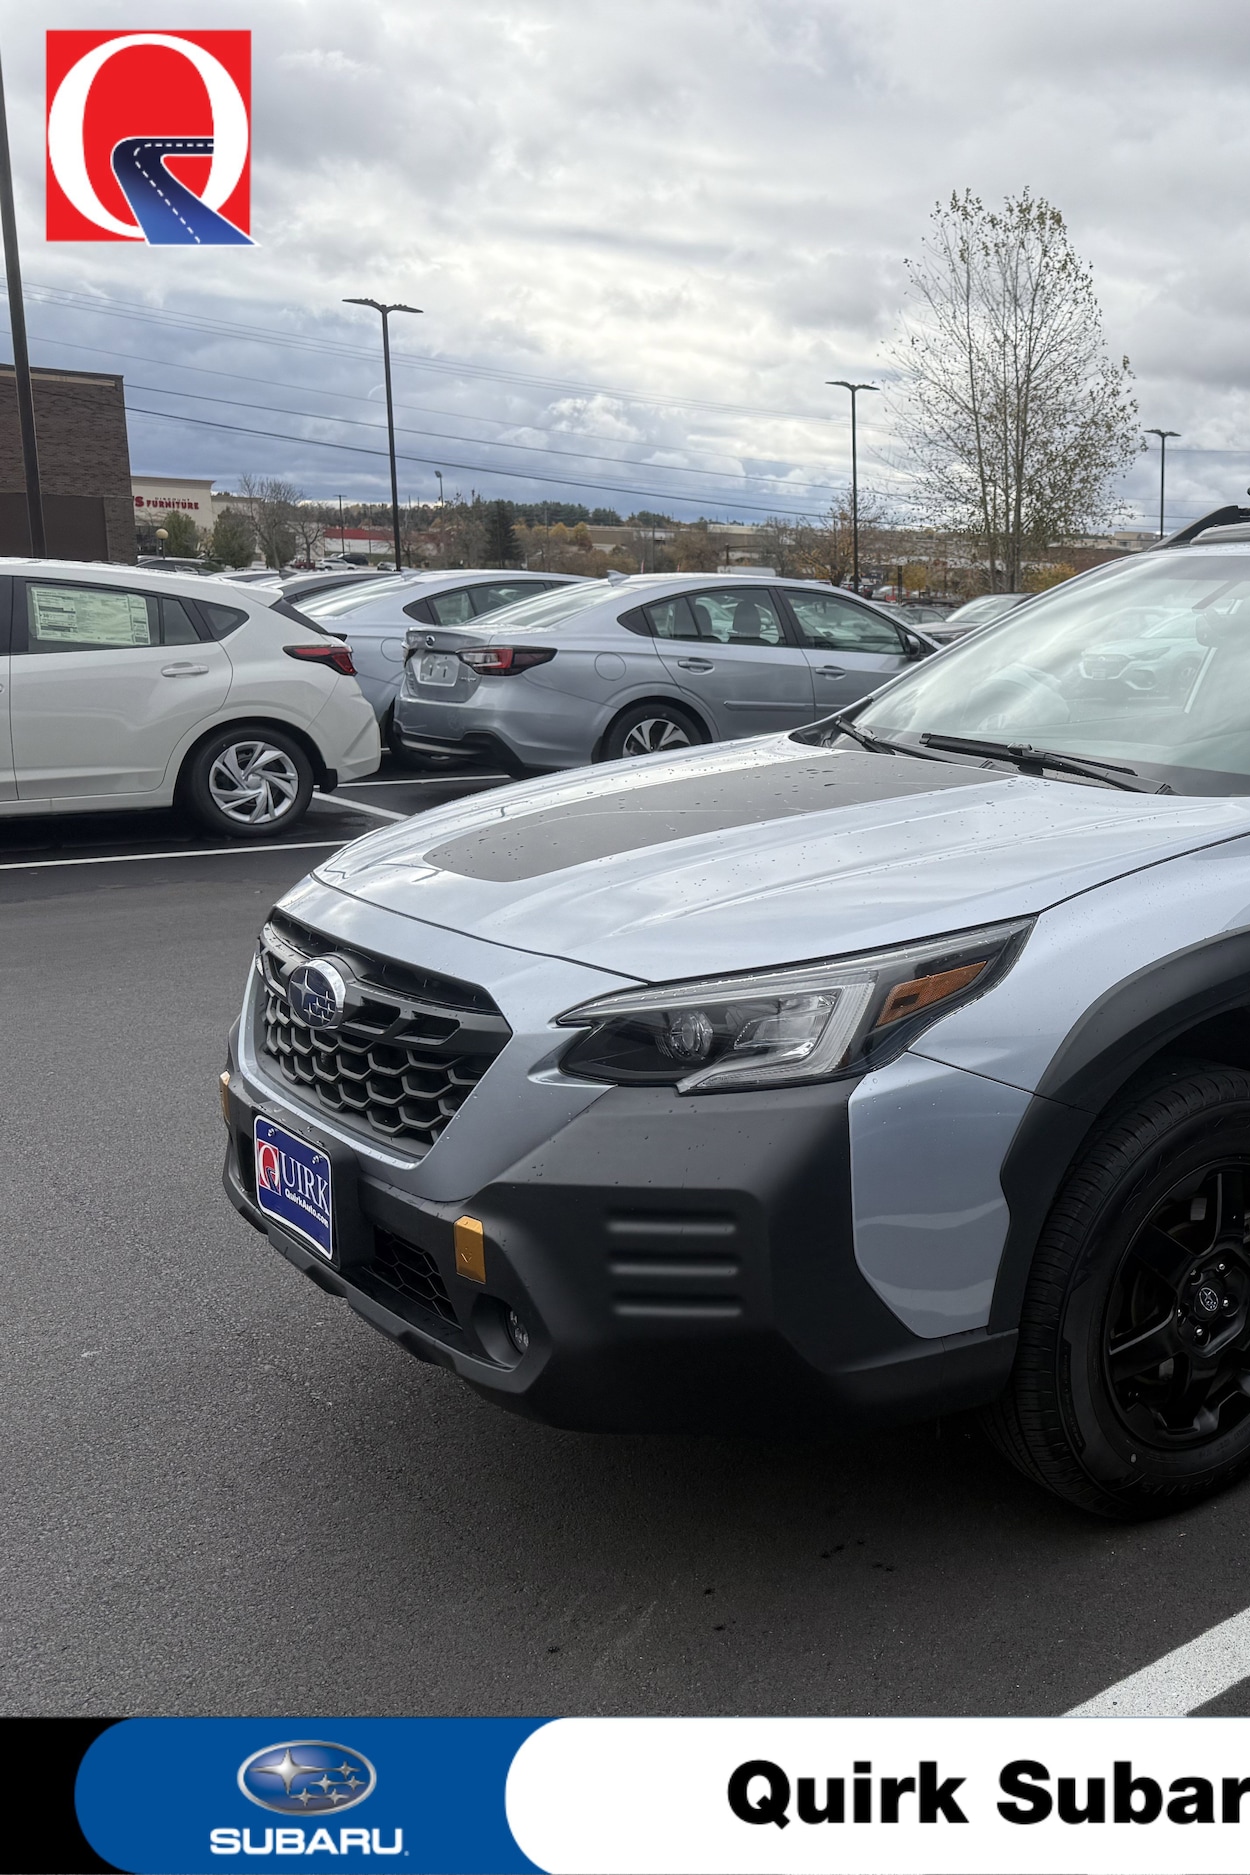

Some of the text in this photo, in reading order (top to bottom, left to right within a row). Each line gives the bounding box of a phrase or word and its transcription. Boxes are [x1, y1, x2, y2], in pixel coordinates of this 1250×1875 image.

[146, 499, 200, 510] FURNITURE
[258, 1144, 330, 1217] QUIRK
[284, 1188, 330, 1229] QuirkAuto.com
